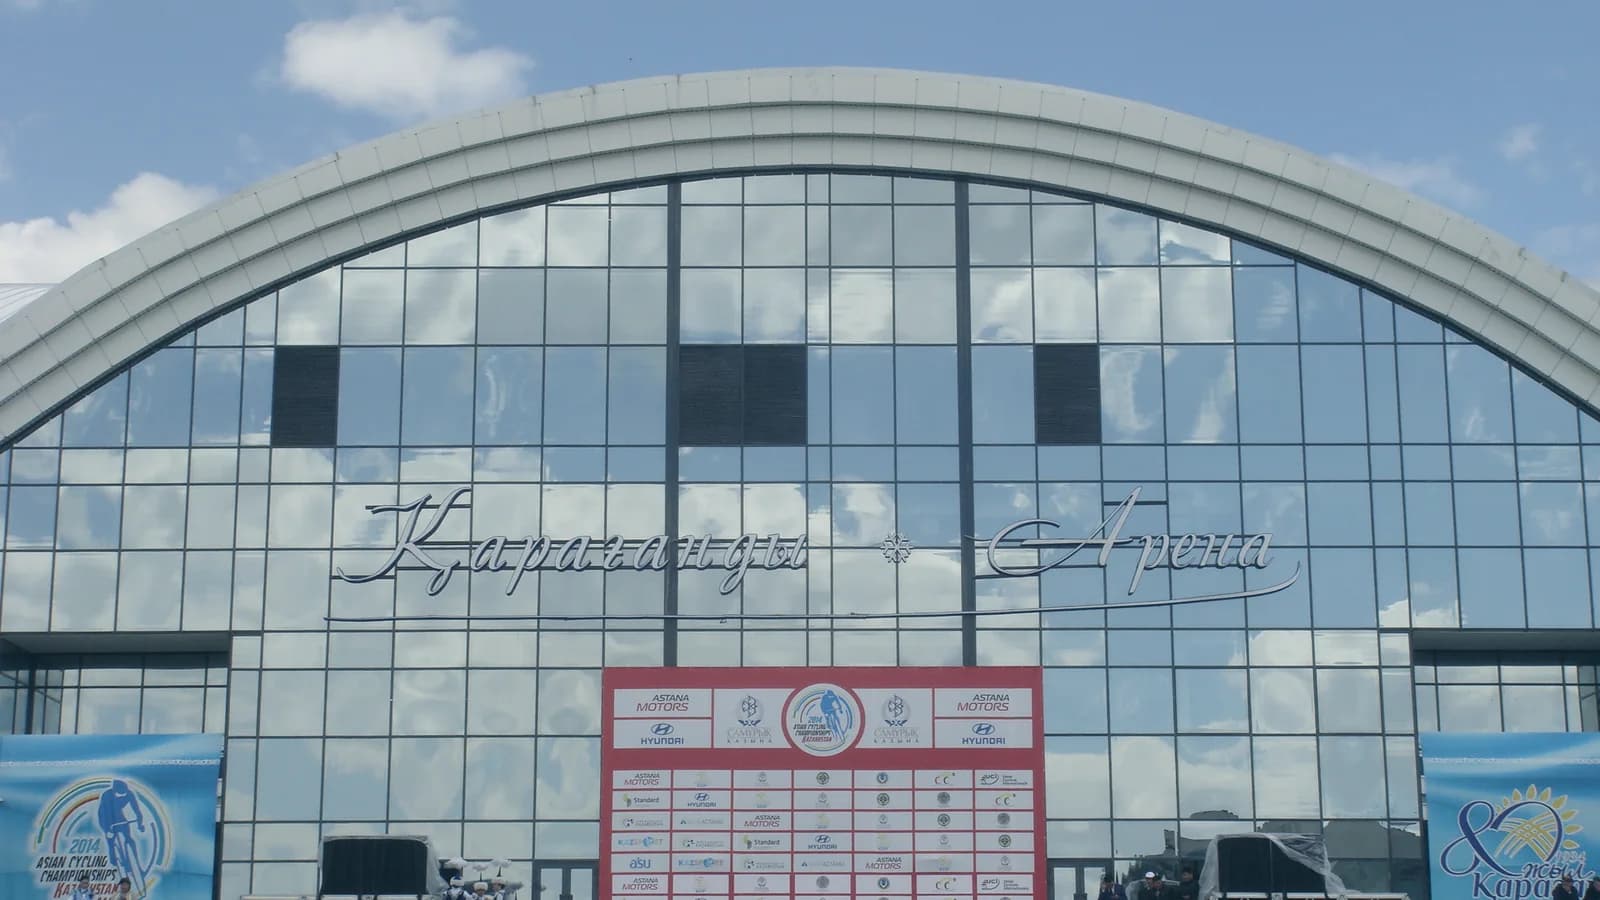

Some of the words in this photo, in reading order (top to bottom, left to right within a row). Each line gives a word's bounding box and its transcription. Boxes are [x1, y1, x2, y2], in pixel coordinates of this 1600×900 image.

[985, 486, 1273, 596] Арена
[652, 694, 689, 702] ASTANA
[972, 694, 1010, 702] ASTANA
[636, 702, 689, 712] MOTORS
[957, 702, 1009, 712] MOTORS
[640, 737, 684, 745] HYUNDAI
[962, 737, 1006, 745] HYUNDAI
[744, 820, 780, 828] MOTORS
[69, 839, 101, 854] 2014
[36, 856, 67, 869] ASIAN
[68, 855, 108, 868] CYCLING
[40, 869, 117, 882] CHAMPIONSHIPS
[622, 883, 658, 891] MOTORS
